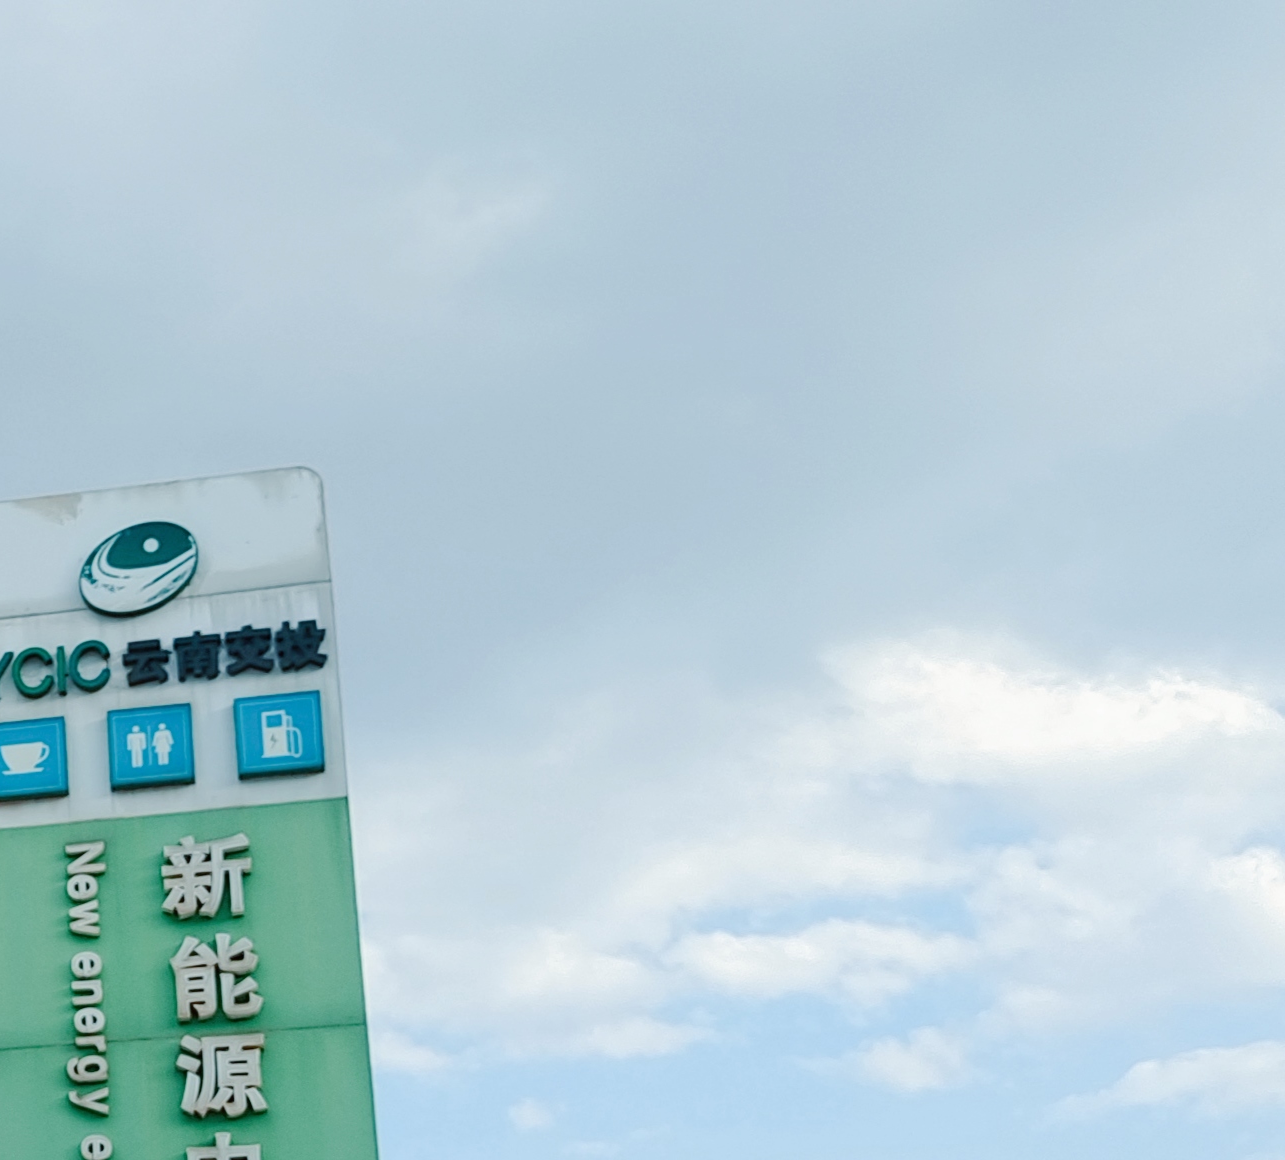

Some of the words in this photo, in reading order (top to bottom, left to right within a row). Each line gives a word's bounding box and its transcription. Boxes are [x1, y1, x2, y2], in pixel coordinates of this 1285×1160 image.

[122, 620, 328, 688] 云南交投
[64, 839, 106, 938] New
[66, 951, 110, 1116] energy
